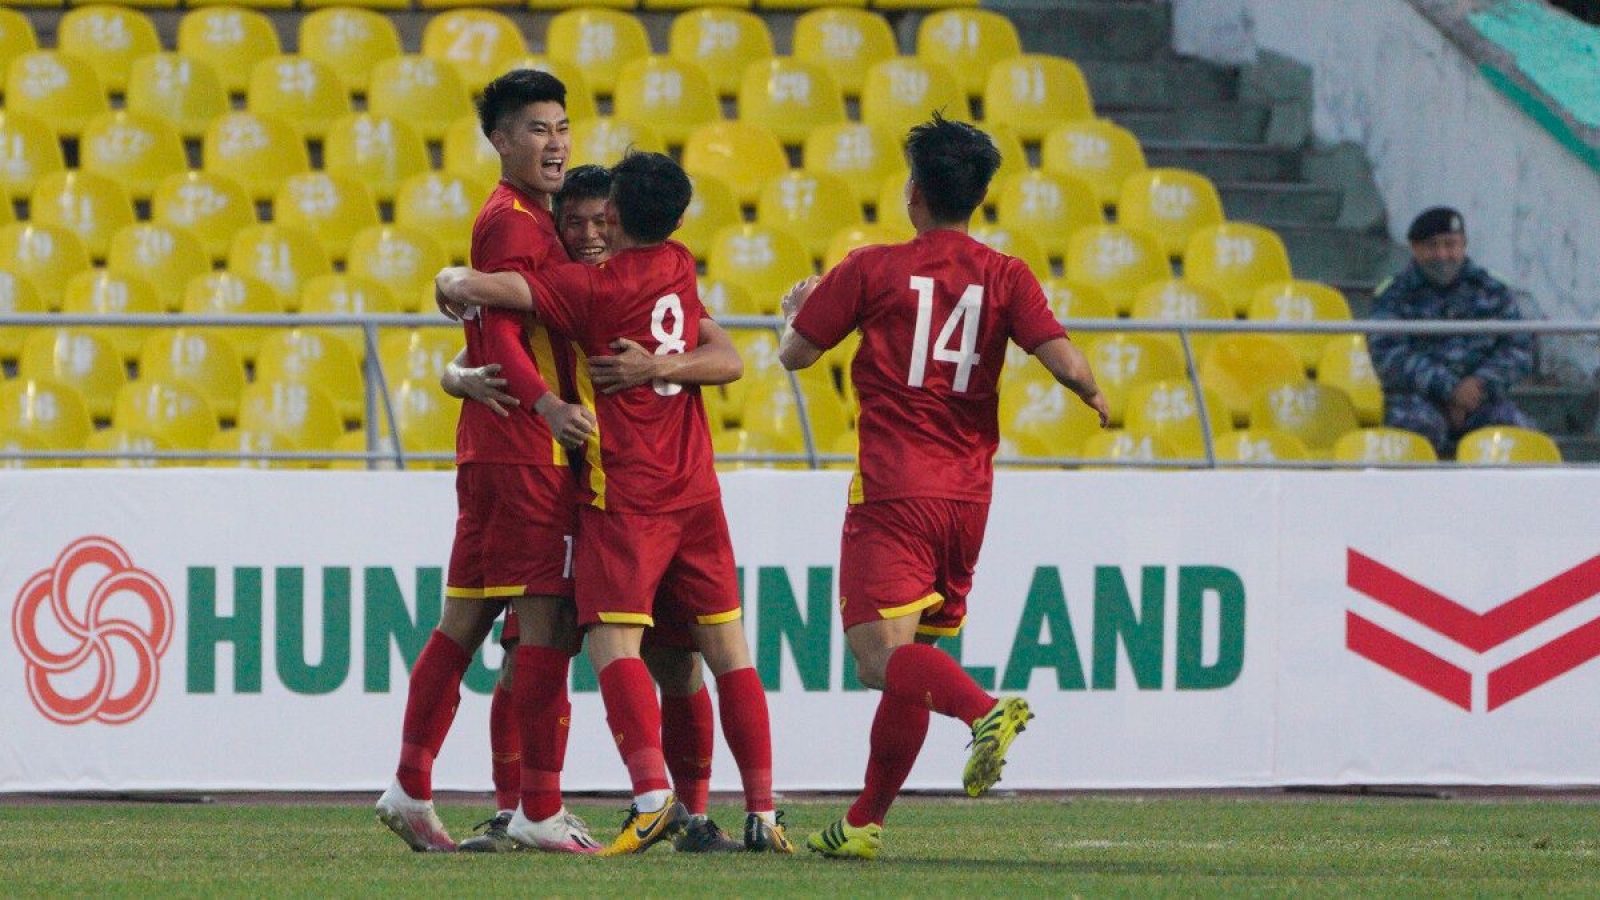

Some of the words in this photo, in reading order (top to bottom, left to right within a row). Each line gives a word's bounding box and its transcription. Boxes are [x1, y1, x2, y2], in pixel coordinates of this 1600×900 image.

[446, 17, 499, 65] 27
[651, 293, 686, 396] 8
[907, 276, 985, 393] 14
[562, 535, 576, 578] 1
